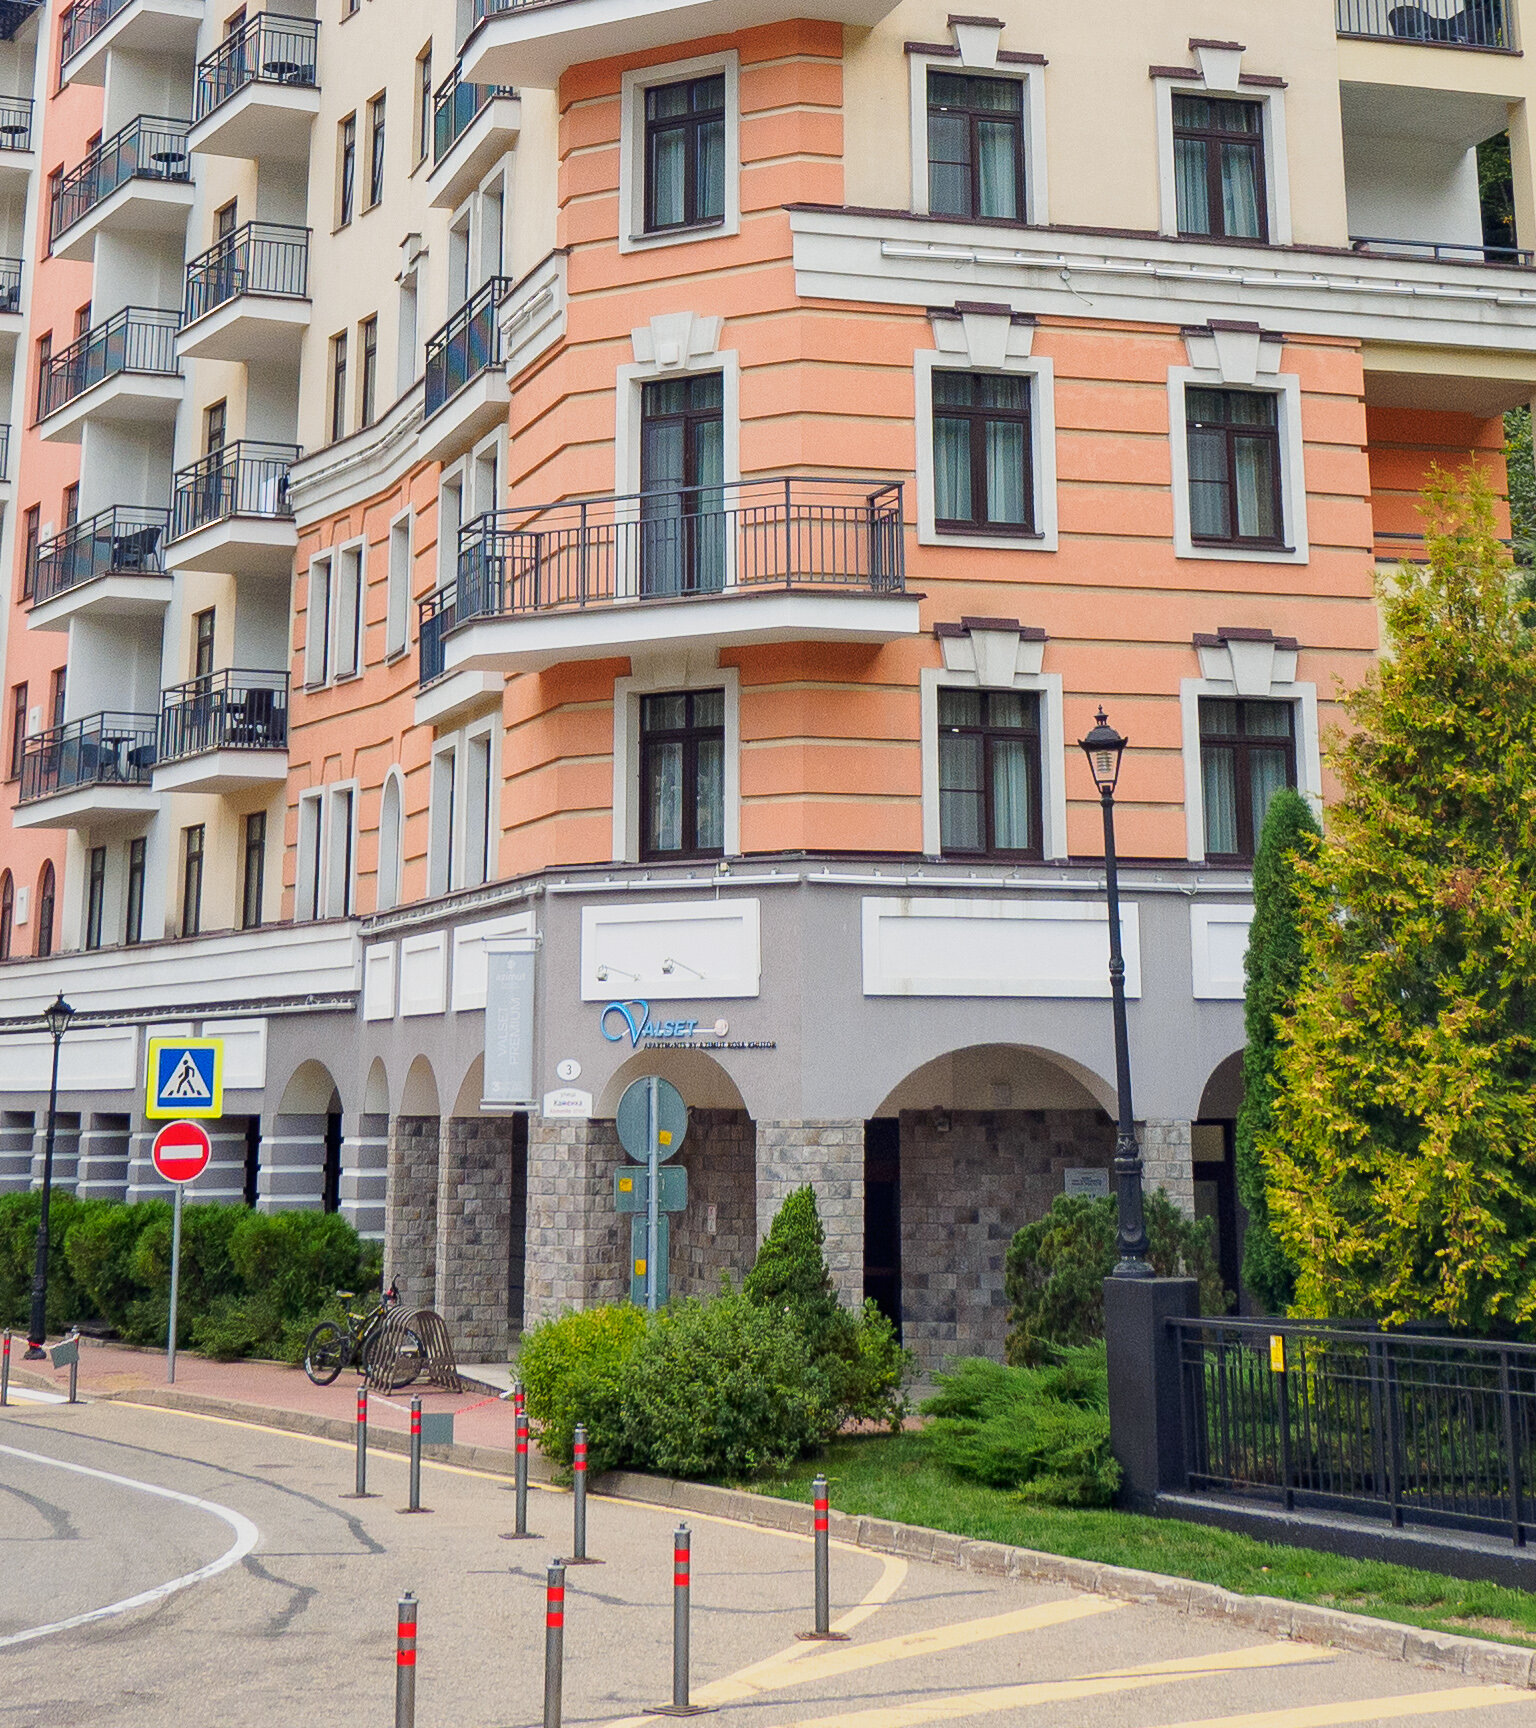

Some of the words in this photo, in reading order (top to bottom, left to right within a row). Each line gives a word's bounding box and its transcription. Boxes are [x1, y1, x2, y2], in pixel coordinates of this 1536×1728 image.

[497, 1007, 508, 1057] VALSET
[509, 997, 521, 1065] PREMIUM
[566, 1064, 572, 1076] 3
